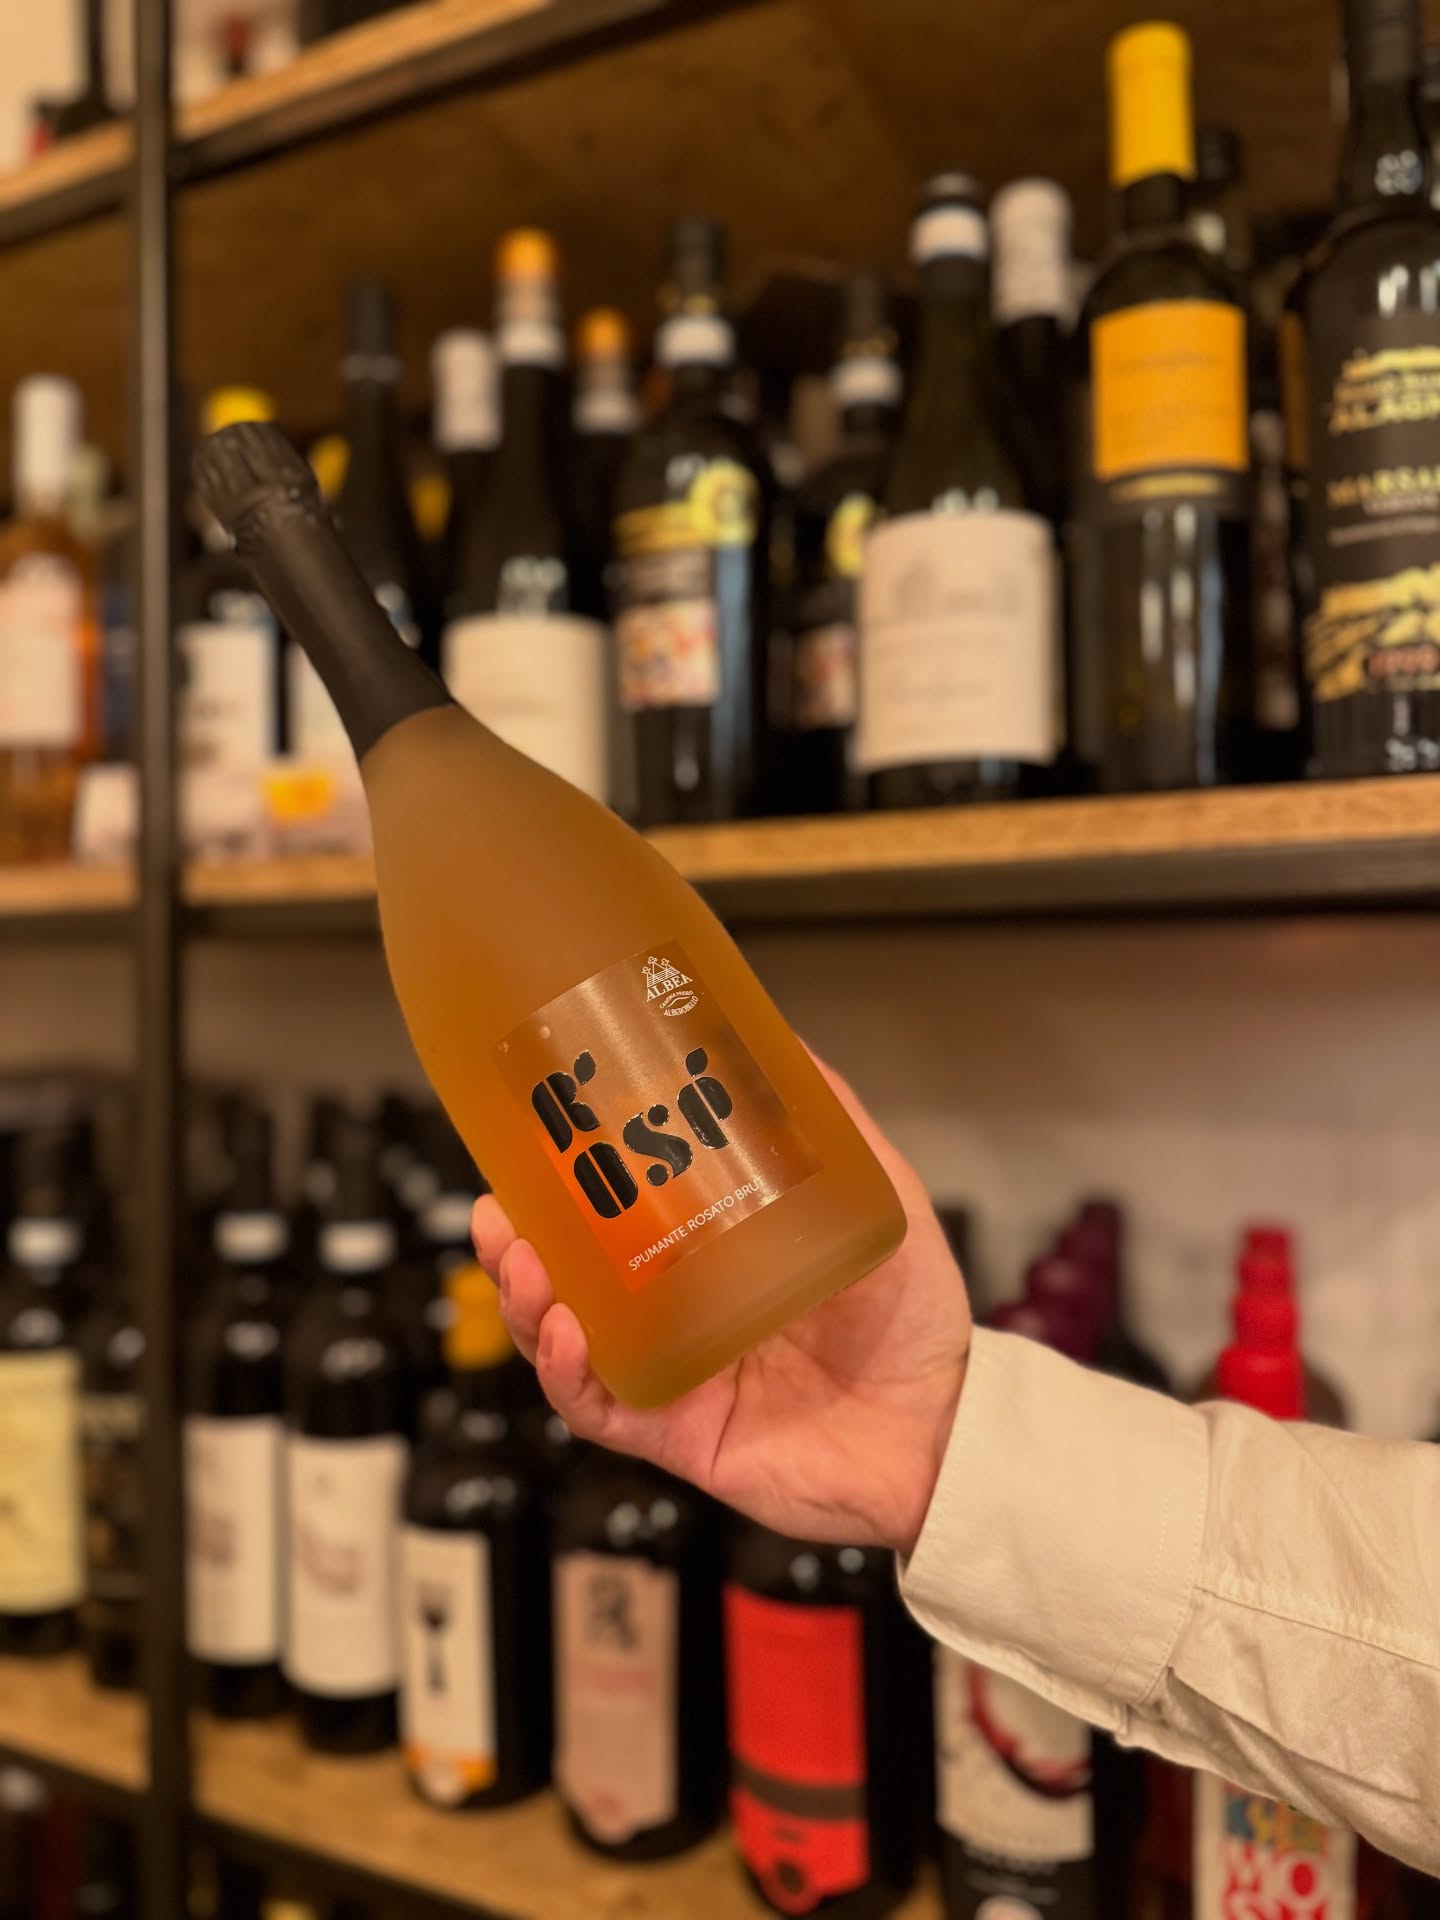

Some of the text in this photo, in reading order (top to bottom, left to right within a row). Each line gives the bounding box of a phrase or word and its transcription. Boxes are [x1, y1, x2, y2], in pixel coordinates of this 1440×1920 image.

[645, 973, 694, 1002] ALBEA
[663, 995, 699, 1017] ALBEROBELLO
[628, 1175, 765, 1271] SPUMANTE ROSATO BRUT
